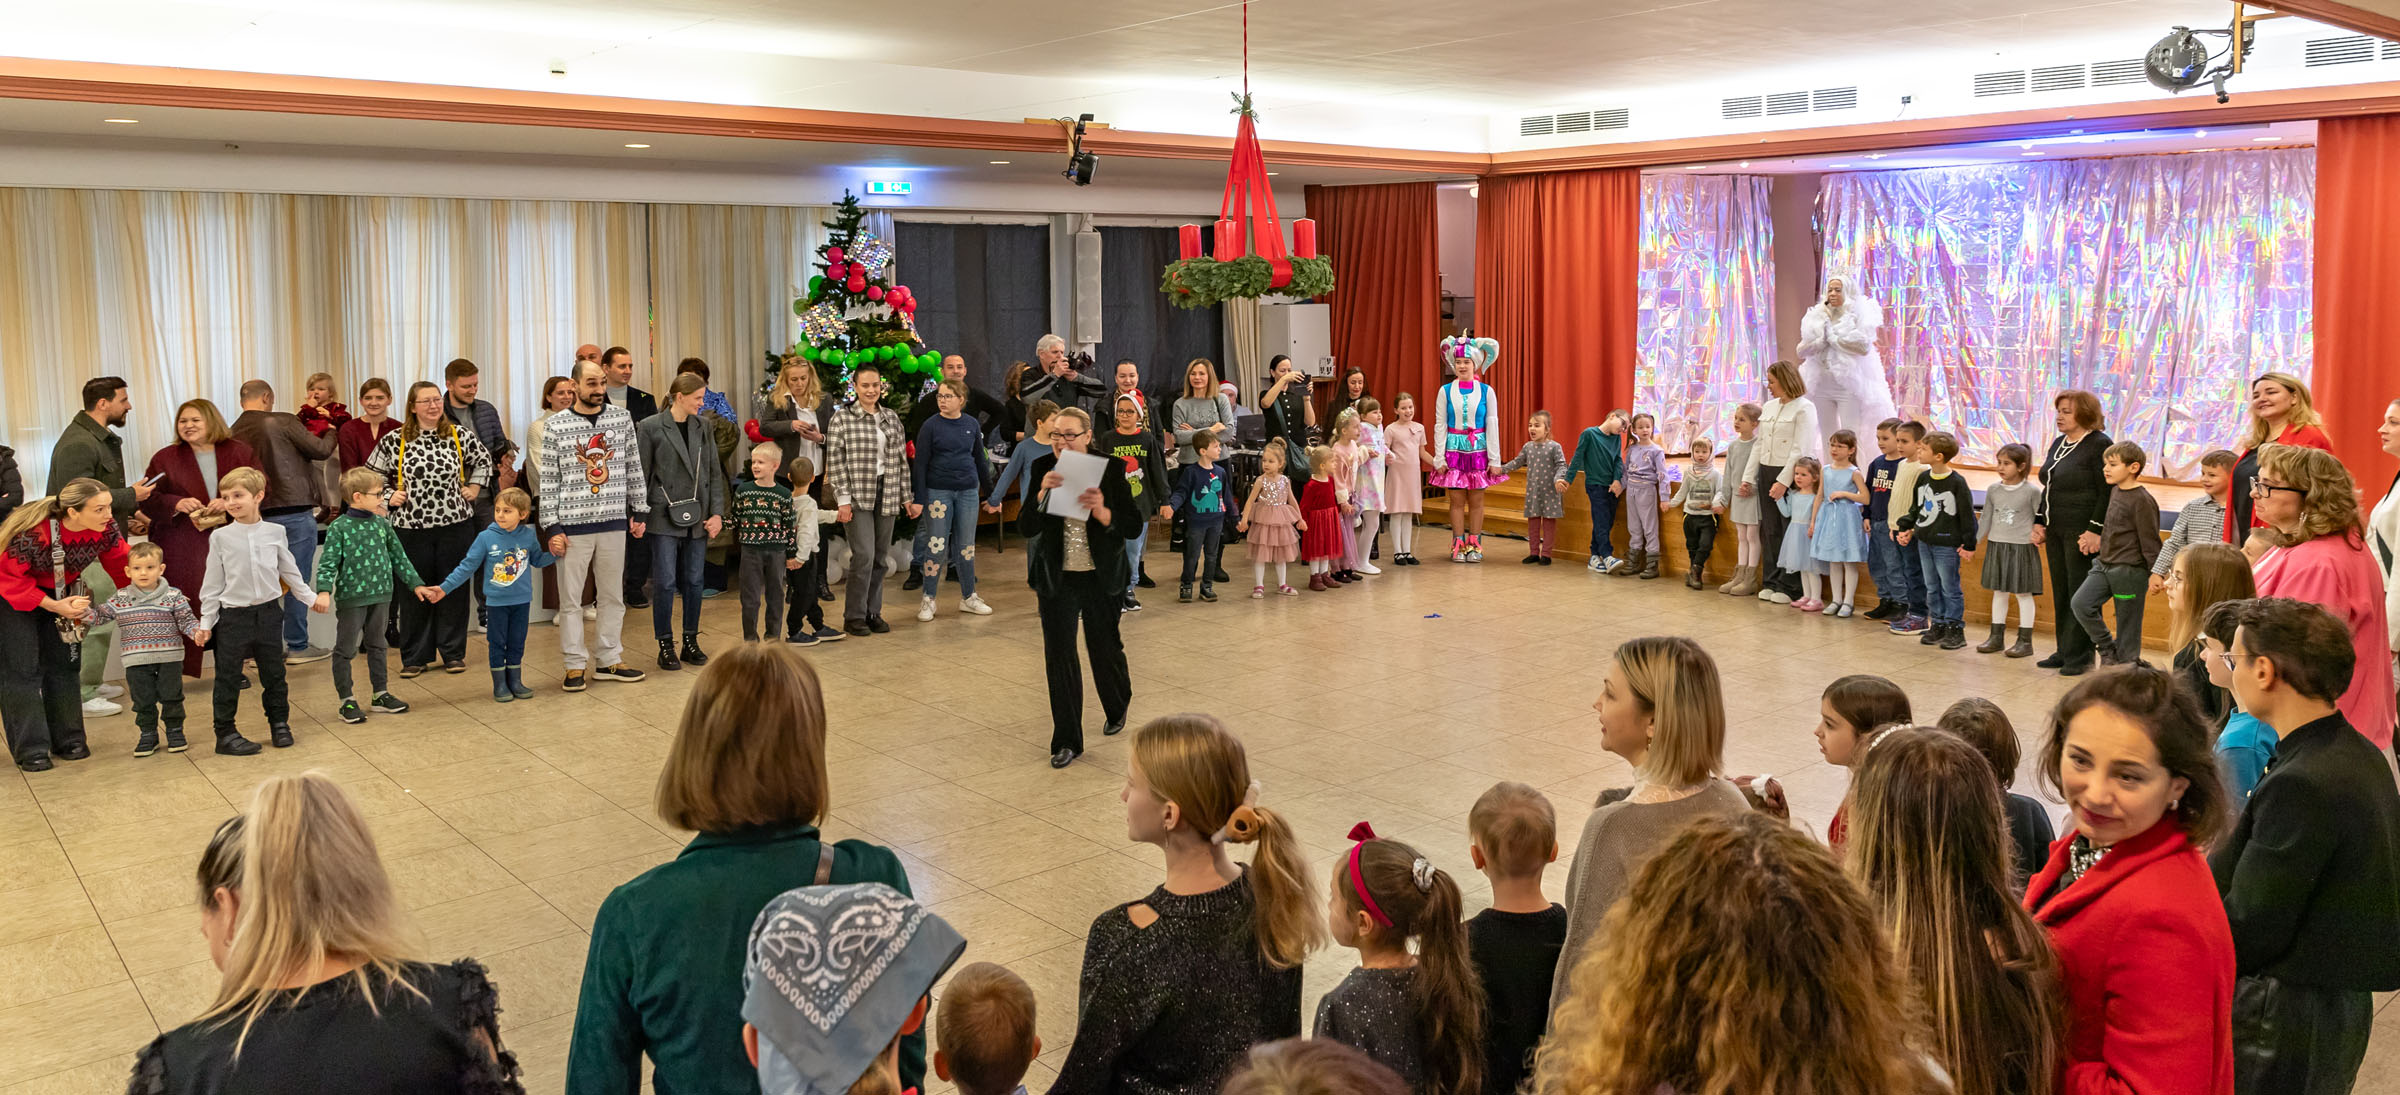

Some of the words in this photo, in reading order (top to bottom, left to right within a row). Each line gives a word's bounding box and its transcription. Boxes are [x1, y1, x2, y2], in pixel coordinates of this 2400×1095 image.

[1113, 444, 1142, 452] MERRY
[1110, 450, 1147, 458] HATEVE
[1877, 469, 1889, 479] BIG
